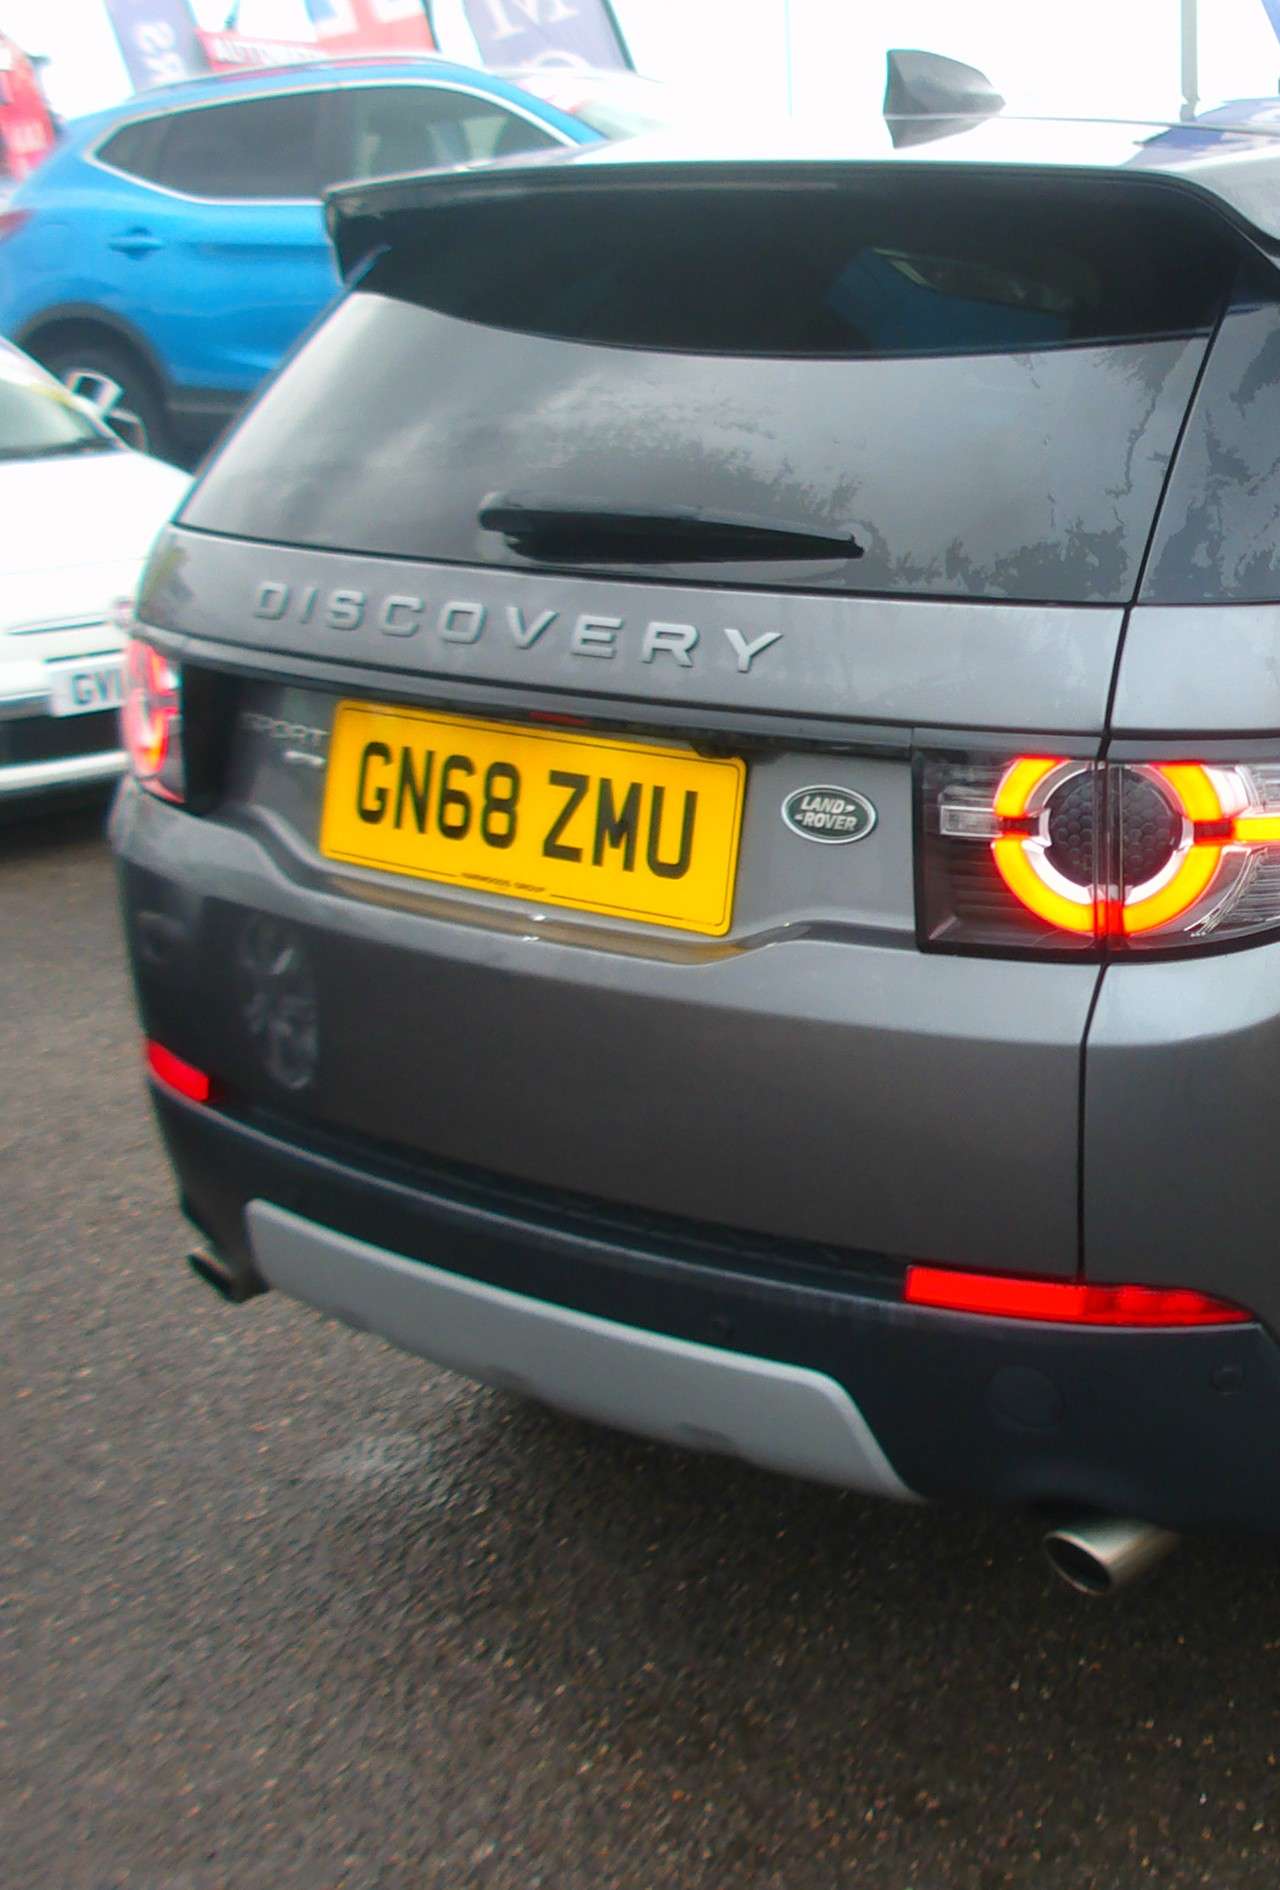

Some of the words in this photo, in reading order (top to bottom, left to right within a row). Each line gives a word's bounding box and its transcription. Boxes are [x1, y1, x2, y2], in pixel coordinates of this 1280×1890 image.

[254, 579, 783, 673] DISCOVERY
[356, 740, 522, 849] GN68
[541, 769, 700, 881] ZMU
[800, 795, 846, 814] LAND
[801, 811, 858, 831] ROVER
